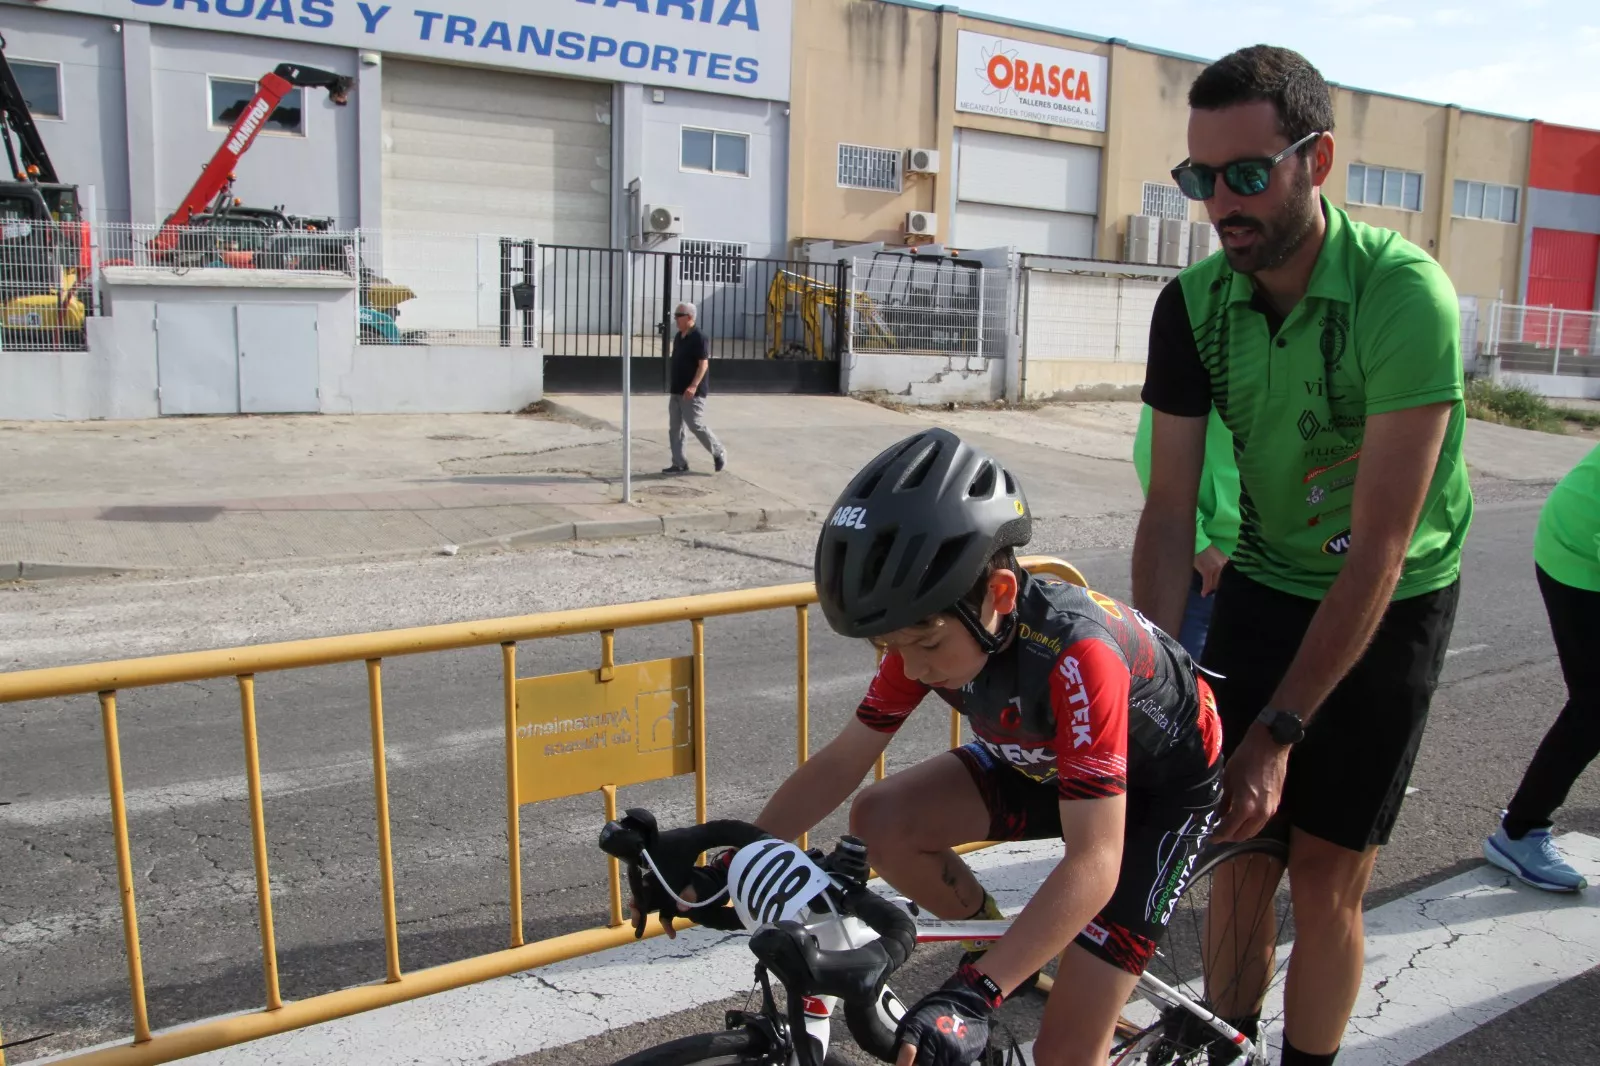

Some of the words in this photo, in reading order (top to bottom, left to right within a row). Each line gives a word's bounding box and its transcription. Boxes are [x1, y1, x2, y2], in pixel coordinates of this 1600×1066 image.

[357, 2, 391, 34] Y
[413, 10, 759, 84] TRANSPORTES
[987, 54, 1092, 103] OBASCA
[1019, 97, 1052, 109] TALLERES
[227, 97, 270, 155] MANITOU
[960, 101, 1008, 115] MECANIZADOS
[1009, 108, 1018, 116] EN
[1020, 110, 1041, 120] TORNO
[829, 505, 867, 530] ABEL
[1142, 699, 1169, 730] Ciclista
[737, 842, 812, 924] 108
[1160, 853, 1197, 926] SANTA
